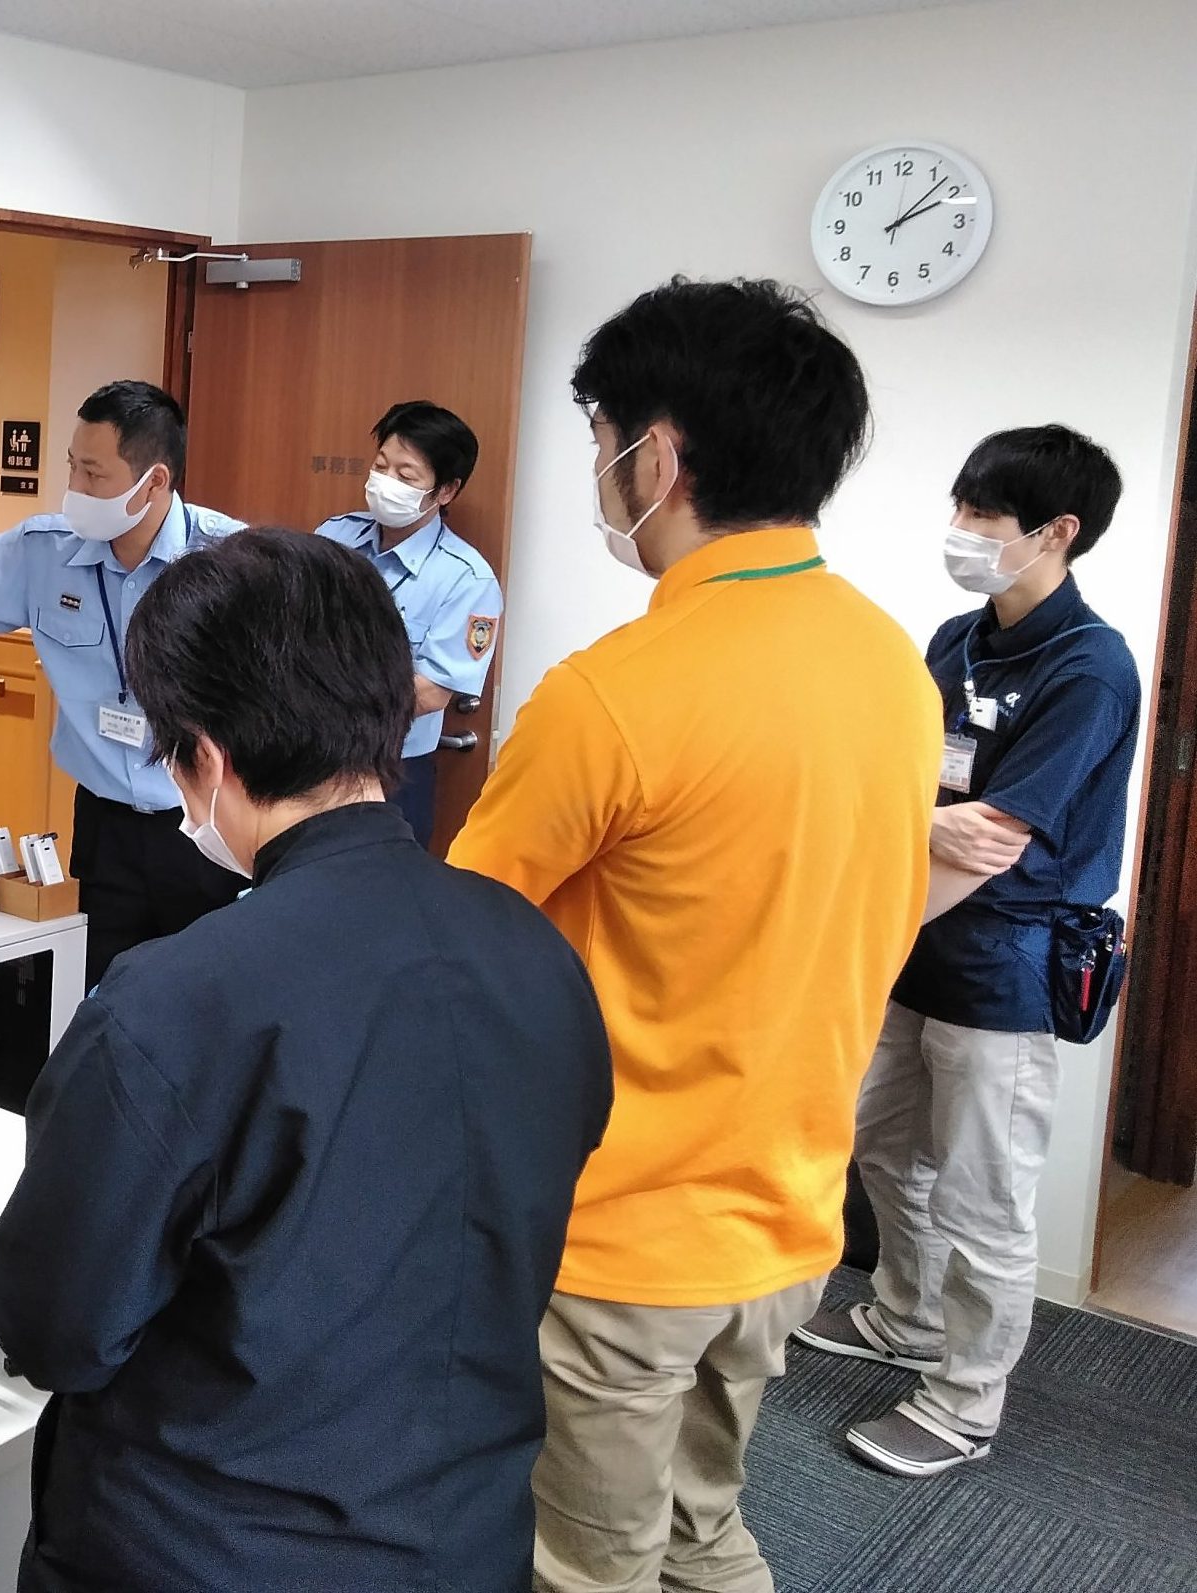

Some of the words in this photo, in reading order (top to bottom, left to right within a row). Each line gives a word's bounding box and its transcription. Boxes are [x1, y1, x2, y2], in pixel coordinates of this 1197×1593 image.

[893, 160, 914, 177] 12
[929, 166, 938, 182] 1
[866, 169, 883, 186] 11
[843, 191, 863, 207] 10
[947, 185, 960, 199] 2
[833, 219, 846, 235] 9
[953, 213, 966, 229] 3
[839, 246, 852, 262] 8
[941, 241, 954, 257] 4
[859, 265, 872, 280] 7
[887, 271, 900, 287] 6
[917, 263, 931, 279] 5
[7, 455, 32, 467] 相談室
[311, 455, 365, 476] 事務室
